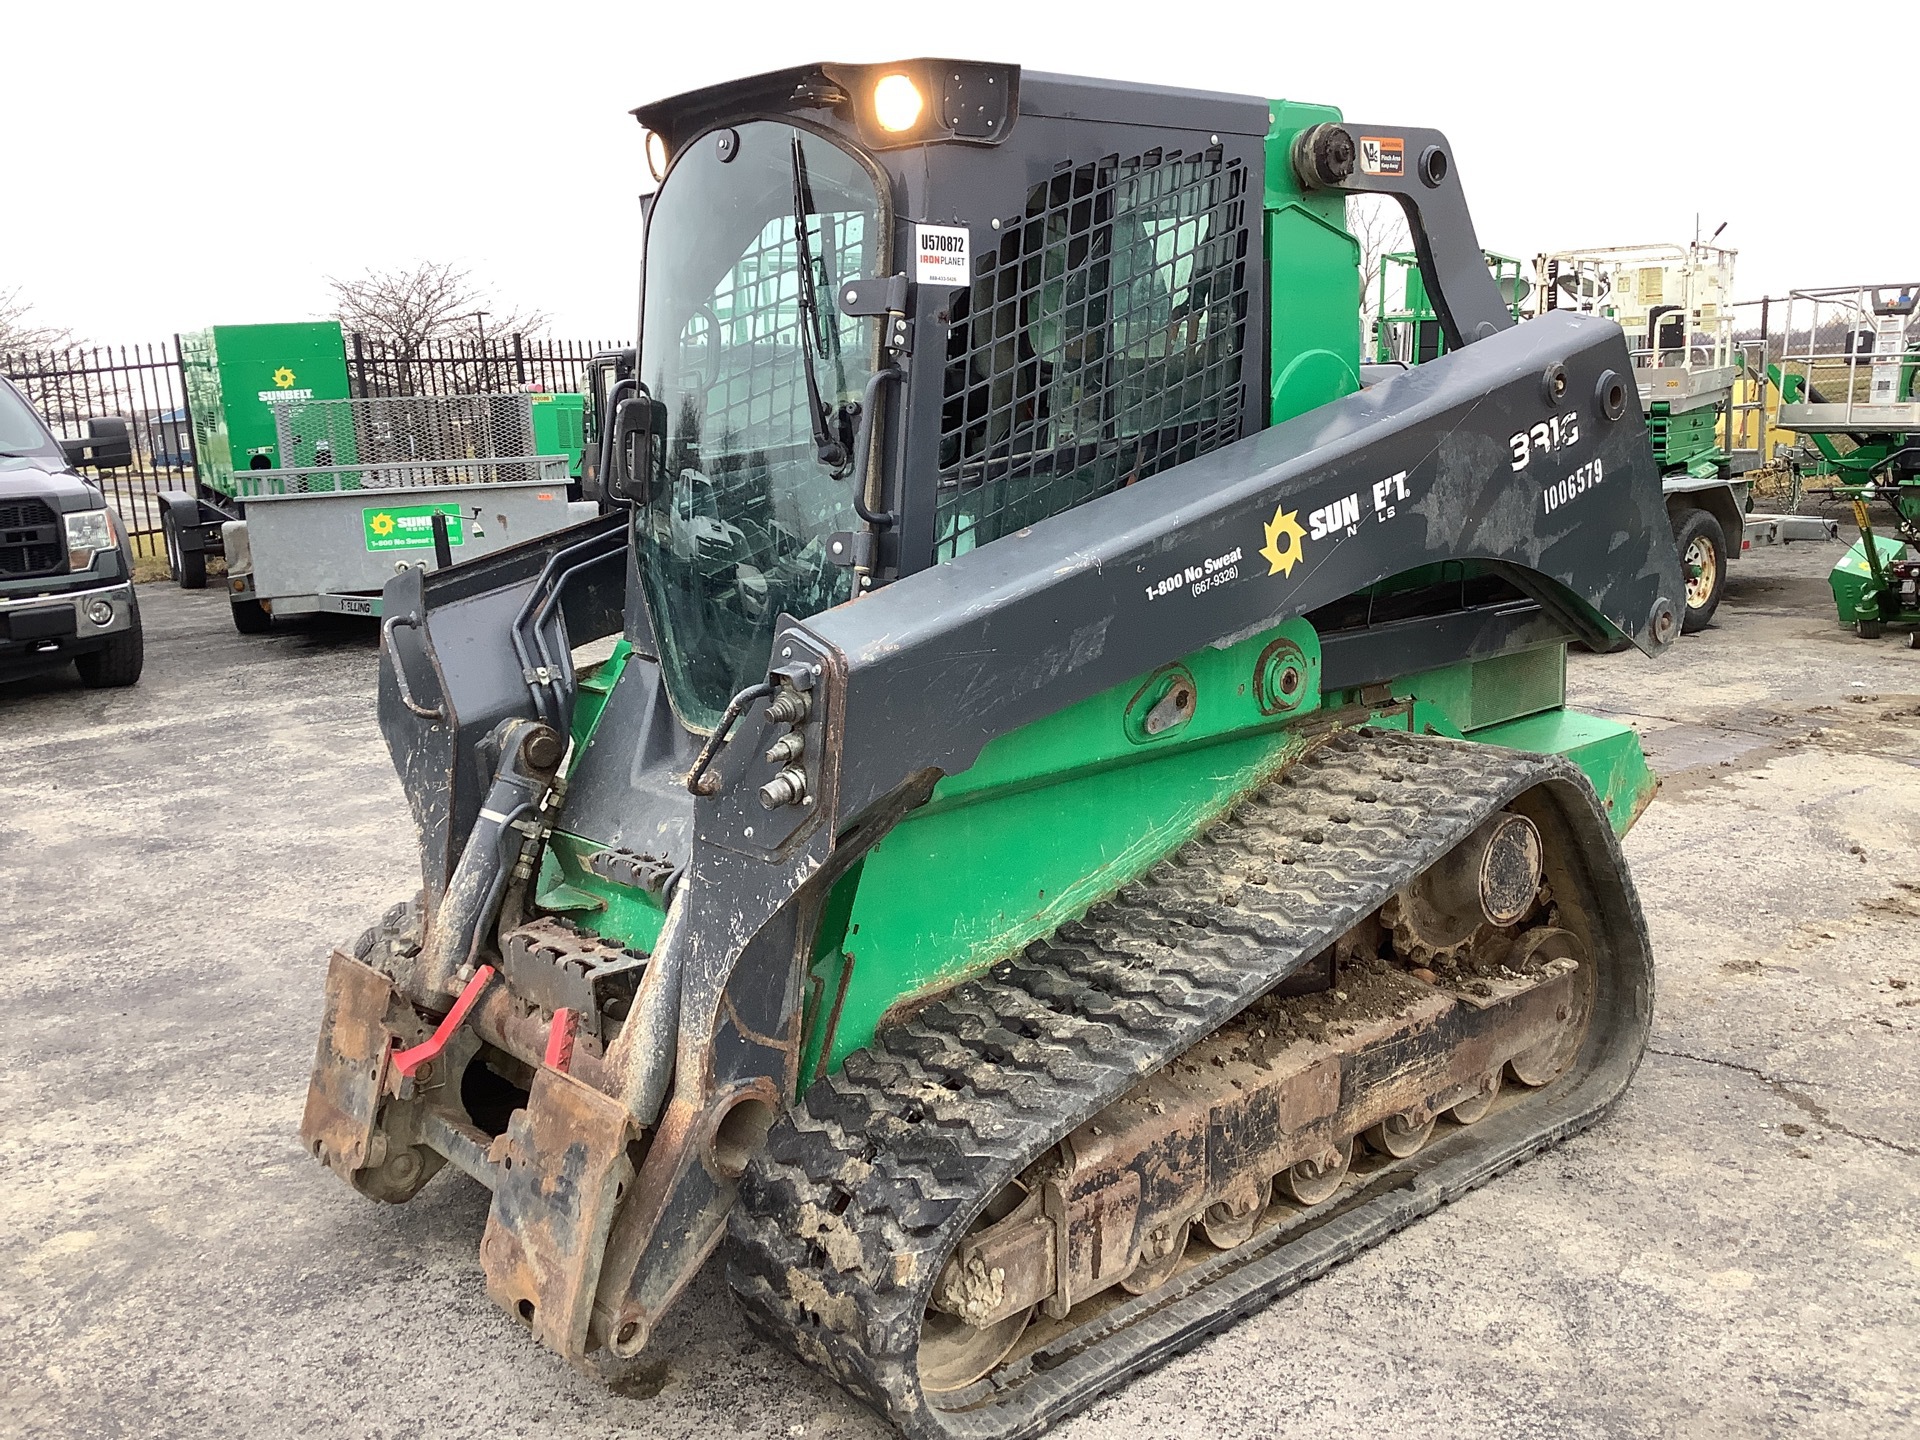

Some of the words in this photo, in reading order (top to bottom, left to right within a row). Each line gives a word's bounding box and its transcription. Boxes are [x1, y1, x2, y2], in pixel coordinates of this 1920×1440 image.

[920, 254, 966, 266] IRONPLANET
[921, 234, 964, 253] U570872
[1543, 458, 1604, 515] 1006579
[1145, 573, 1183, 601] 1-800
[1184, 565, 1203, 583] No
[1204, 546, 1243, 574] Sweat
[1191, 564, 1239, 598] (667-9328)
